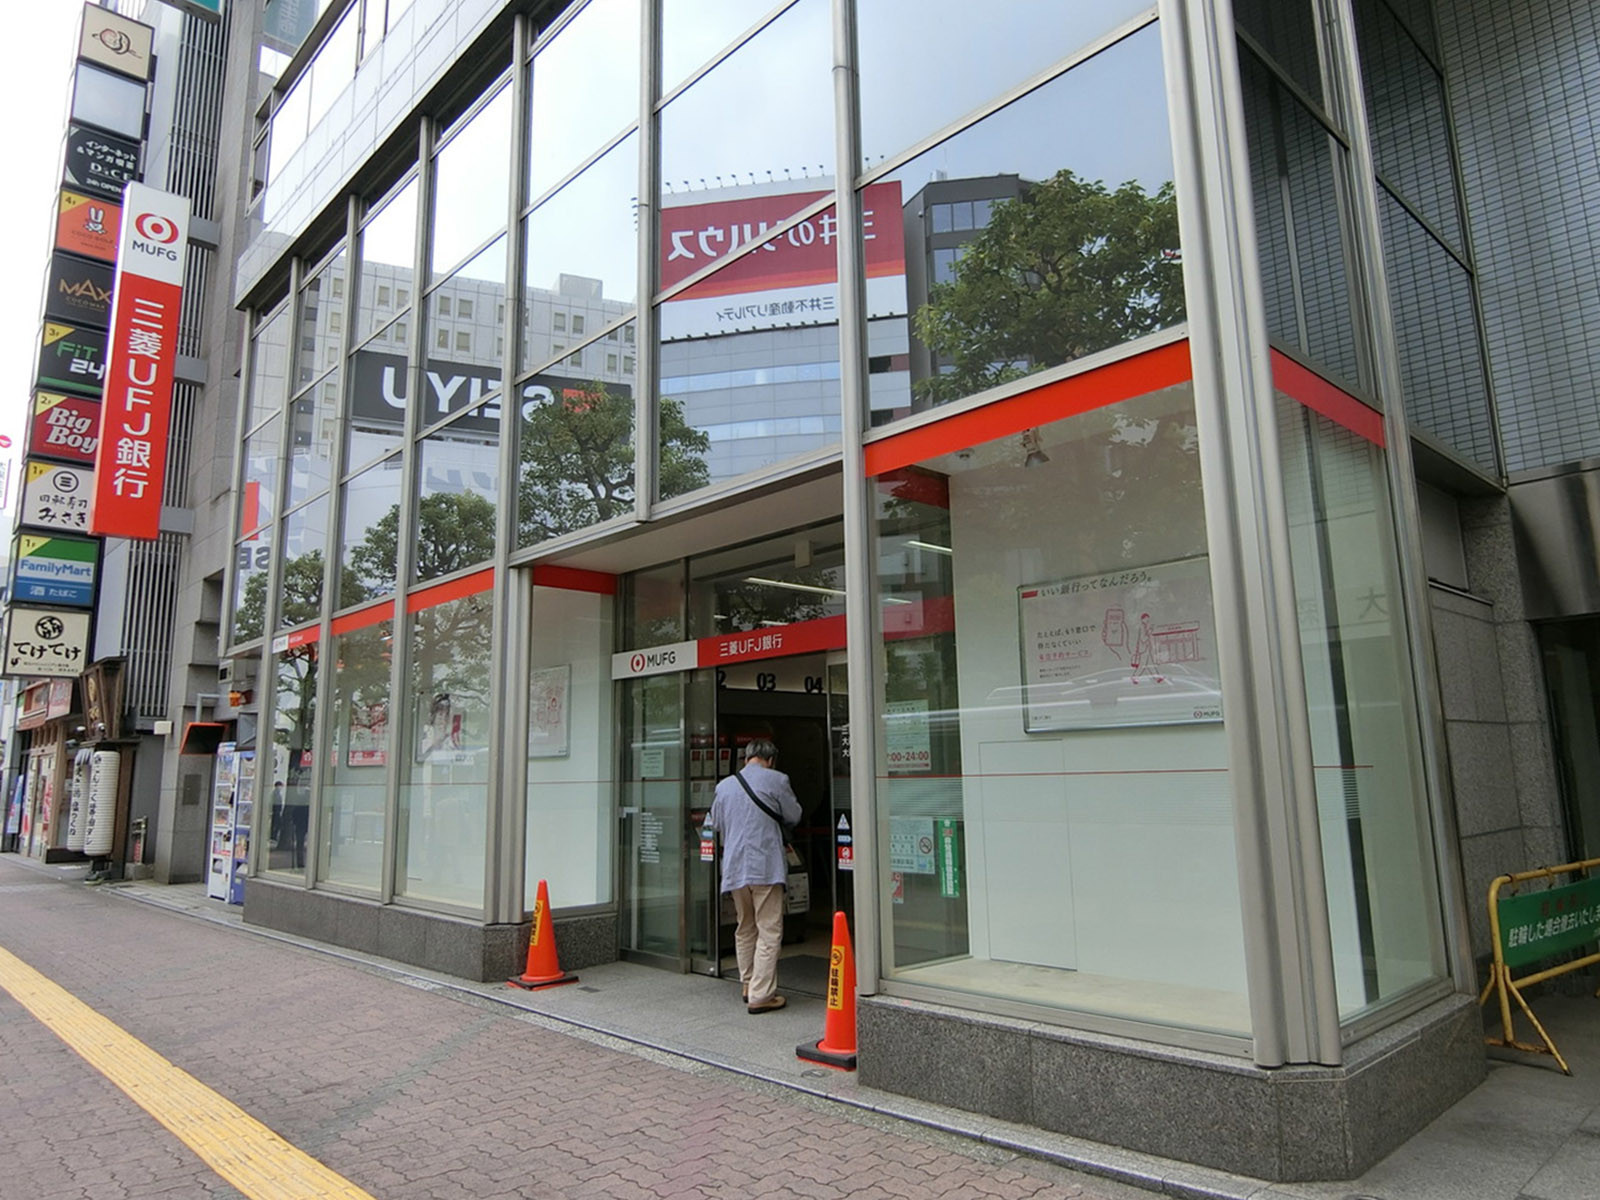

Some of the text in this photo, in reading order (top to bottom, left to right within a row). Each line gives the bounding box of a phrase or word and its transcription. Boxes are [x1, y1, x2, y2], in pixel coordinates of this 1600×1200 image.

[132, 240, 178, 262] MUFG
[59, 278, 113, 304] MAX
[113, 298, 165, 499] 三菱UFJ銀行
[46, 406, 92, 434] Big
[46, 426, 99, 454] Boy
[38, 507, 87, 527] みさき
[19, 558, 93, 578] FamilyMart
[48, 587, 78, 599] たばこ
[1040, 571, 1152, 597] いい銀行ってなんだろう。
[13, 642, 82, 661] てけてけ
[719, 633, 783, 658] 三菱UFJ銀行
[646, 650, 677, 668] MUFG
[756, 672, 777, 692] 03
[804, 675, 824, 694] 04
